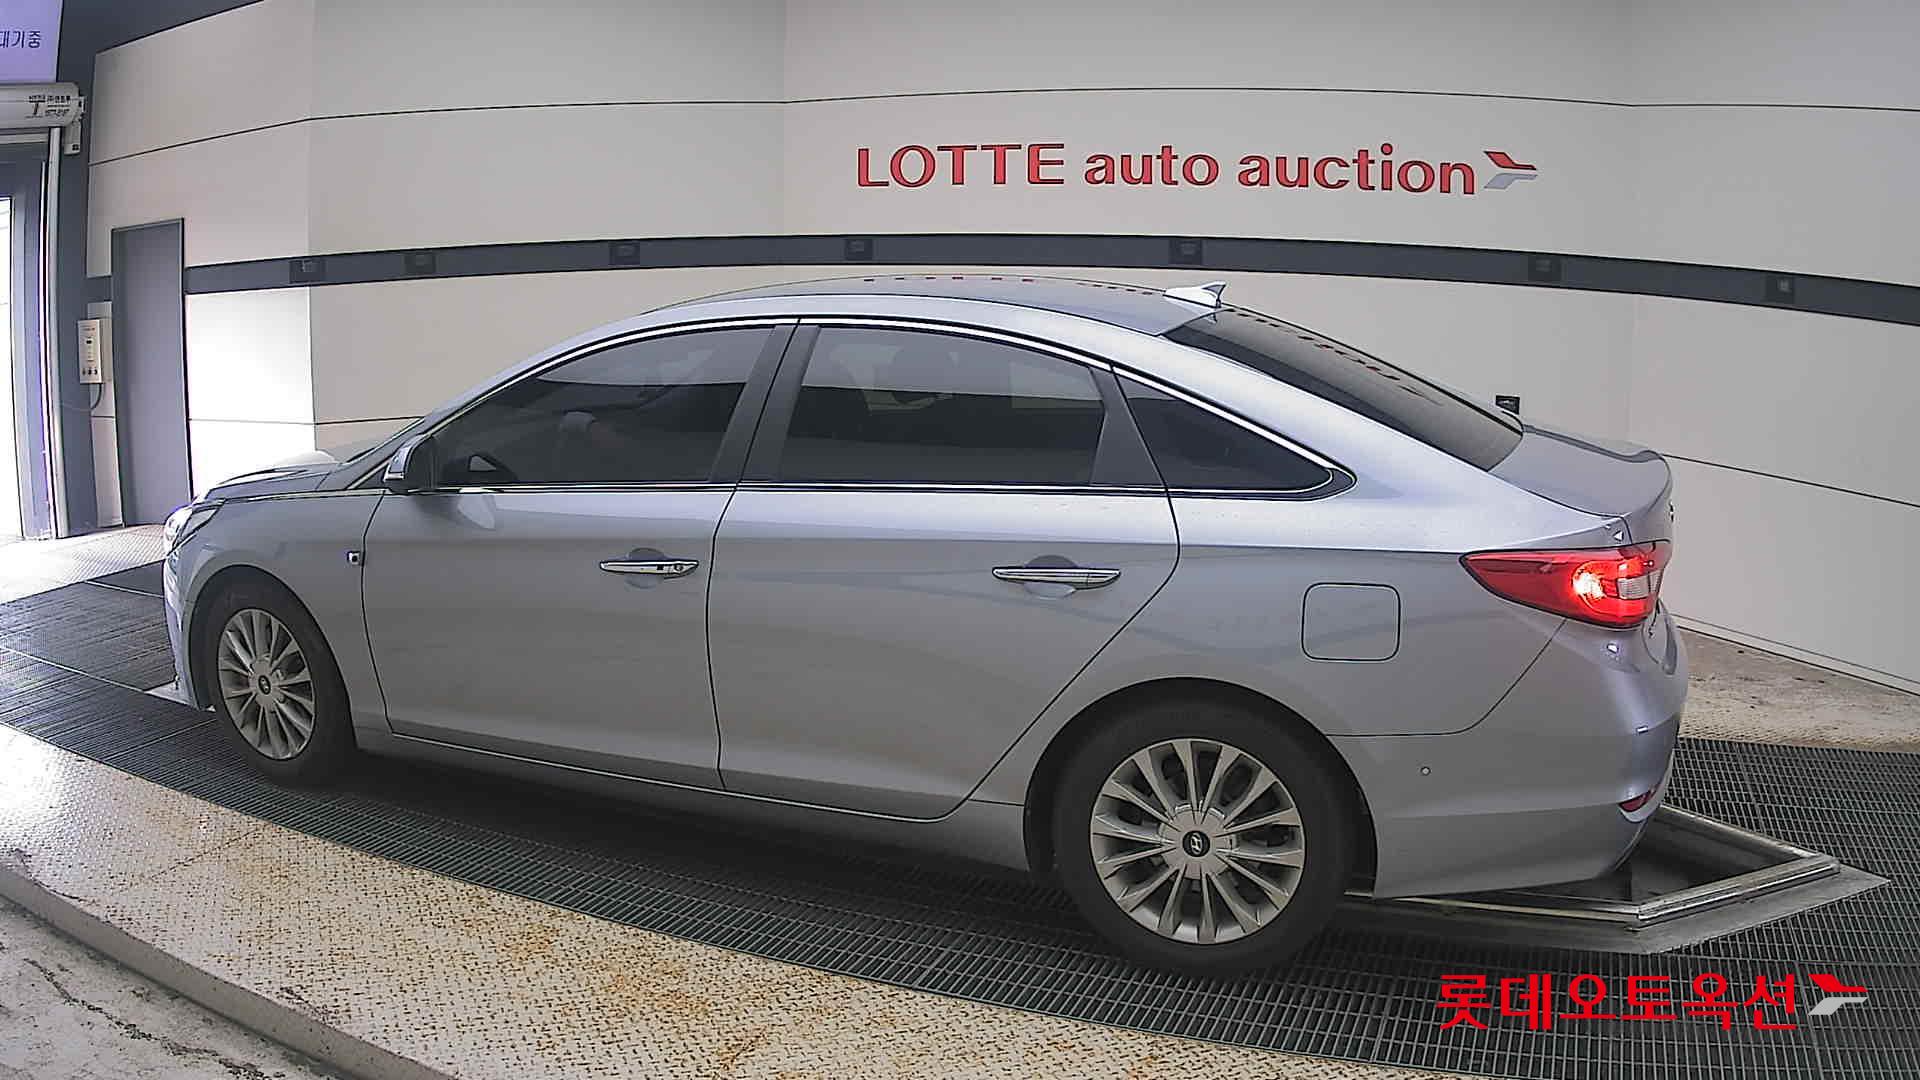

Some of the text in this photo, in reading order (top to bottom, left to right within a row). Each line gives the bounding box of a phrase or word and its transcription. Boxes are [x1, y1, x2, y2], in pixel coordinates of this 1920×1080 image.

[857, 142, 1477, 195] LOTTE auto auction
